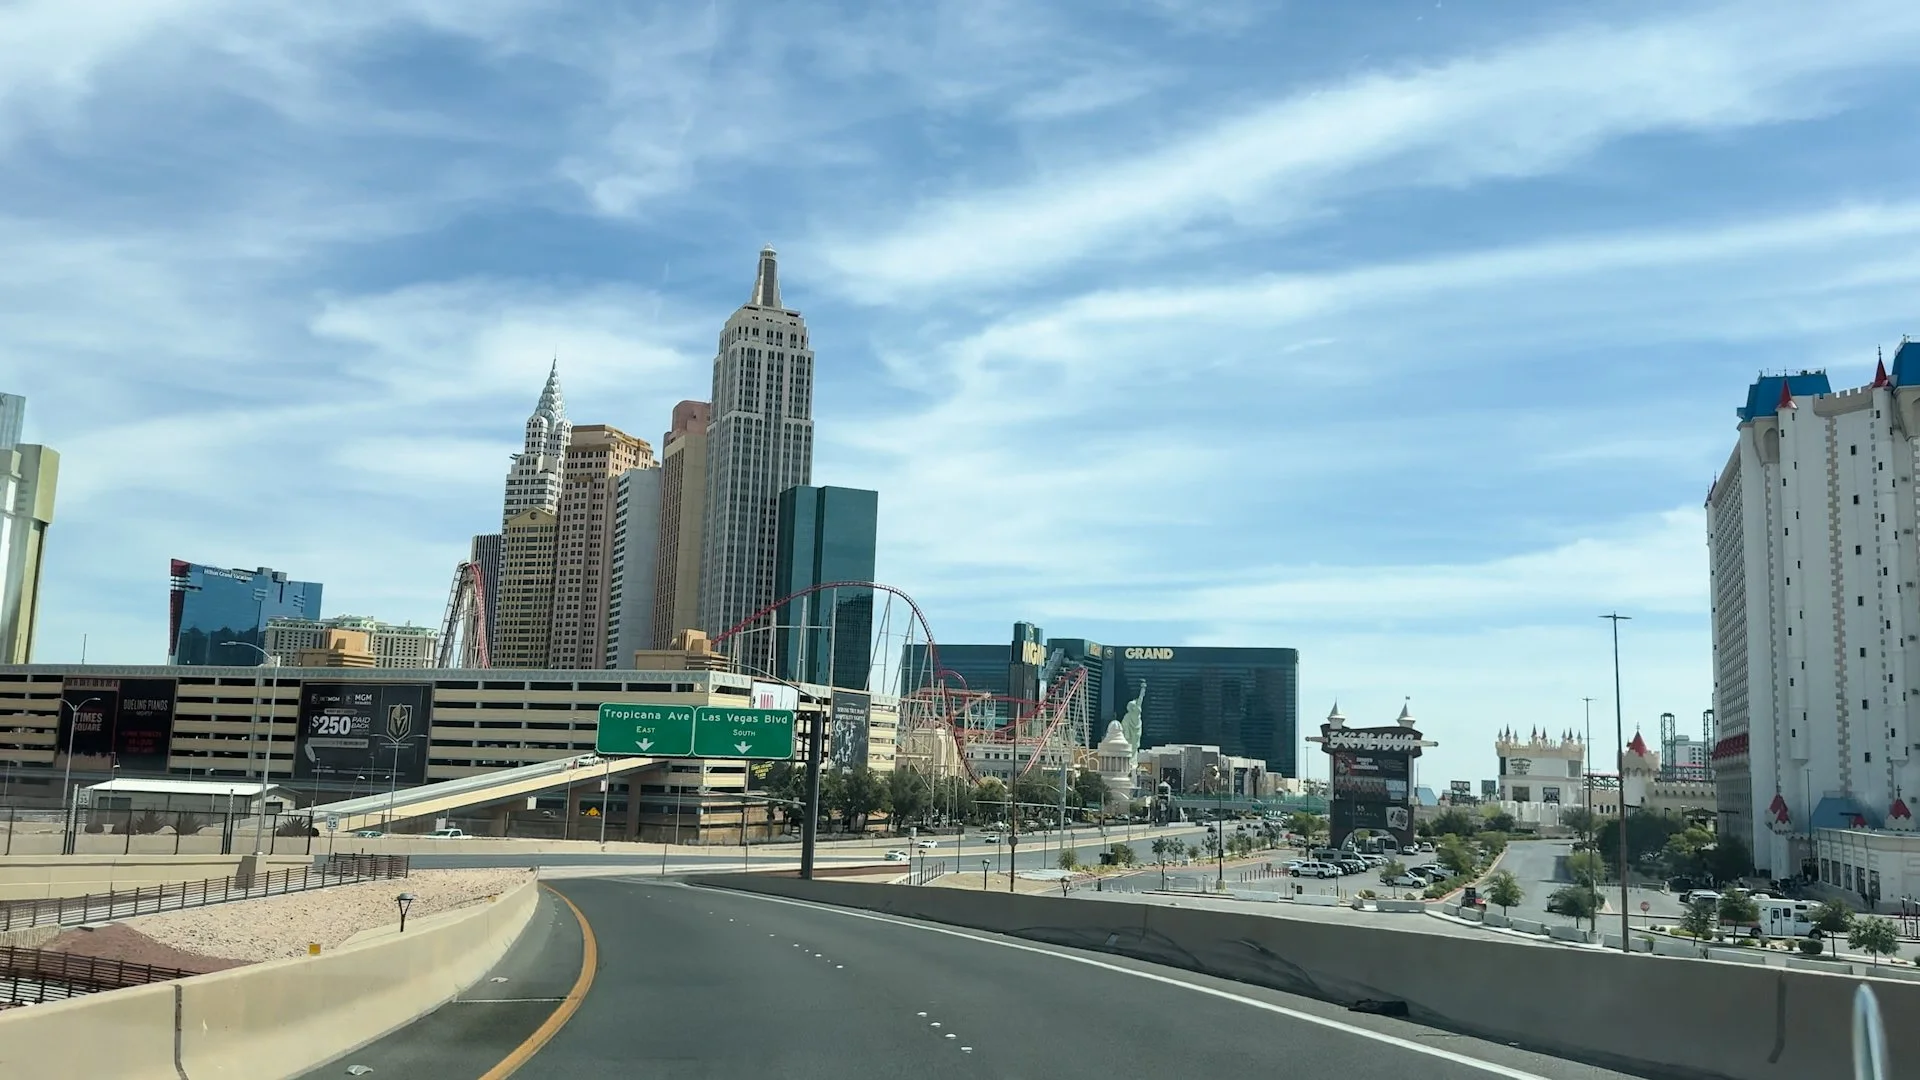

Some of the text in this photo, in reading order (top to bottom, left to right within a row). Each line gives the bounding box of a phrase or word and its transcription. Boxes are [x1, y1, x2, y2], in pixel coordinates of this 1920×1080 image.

[1125, 647, 1174, 660] GRAND
[123, 699, 169, 711] DUELING PIANOS
[75, 712, 103, 723] TIMES
[604, 709, 690, 722] Tropicana Ave
[702, 712, 788, 725] Las Vegas Blvd
[312, 715, 351, 735] $250
[733, 729, 755, 737] SOUTH
[1327, 731, 1415, 751] EXCALIBUR
